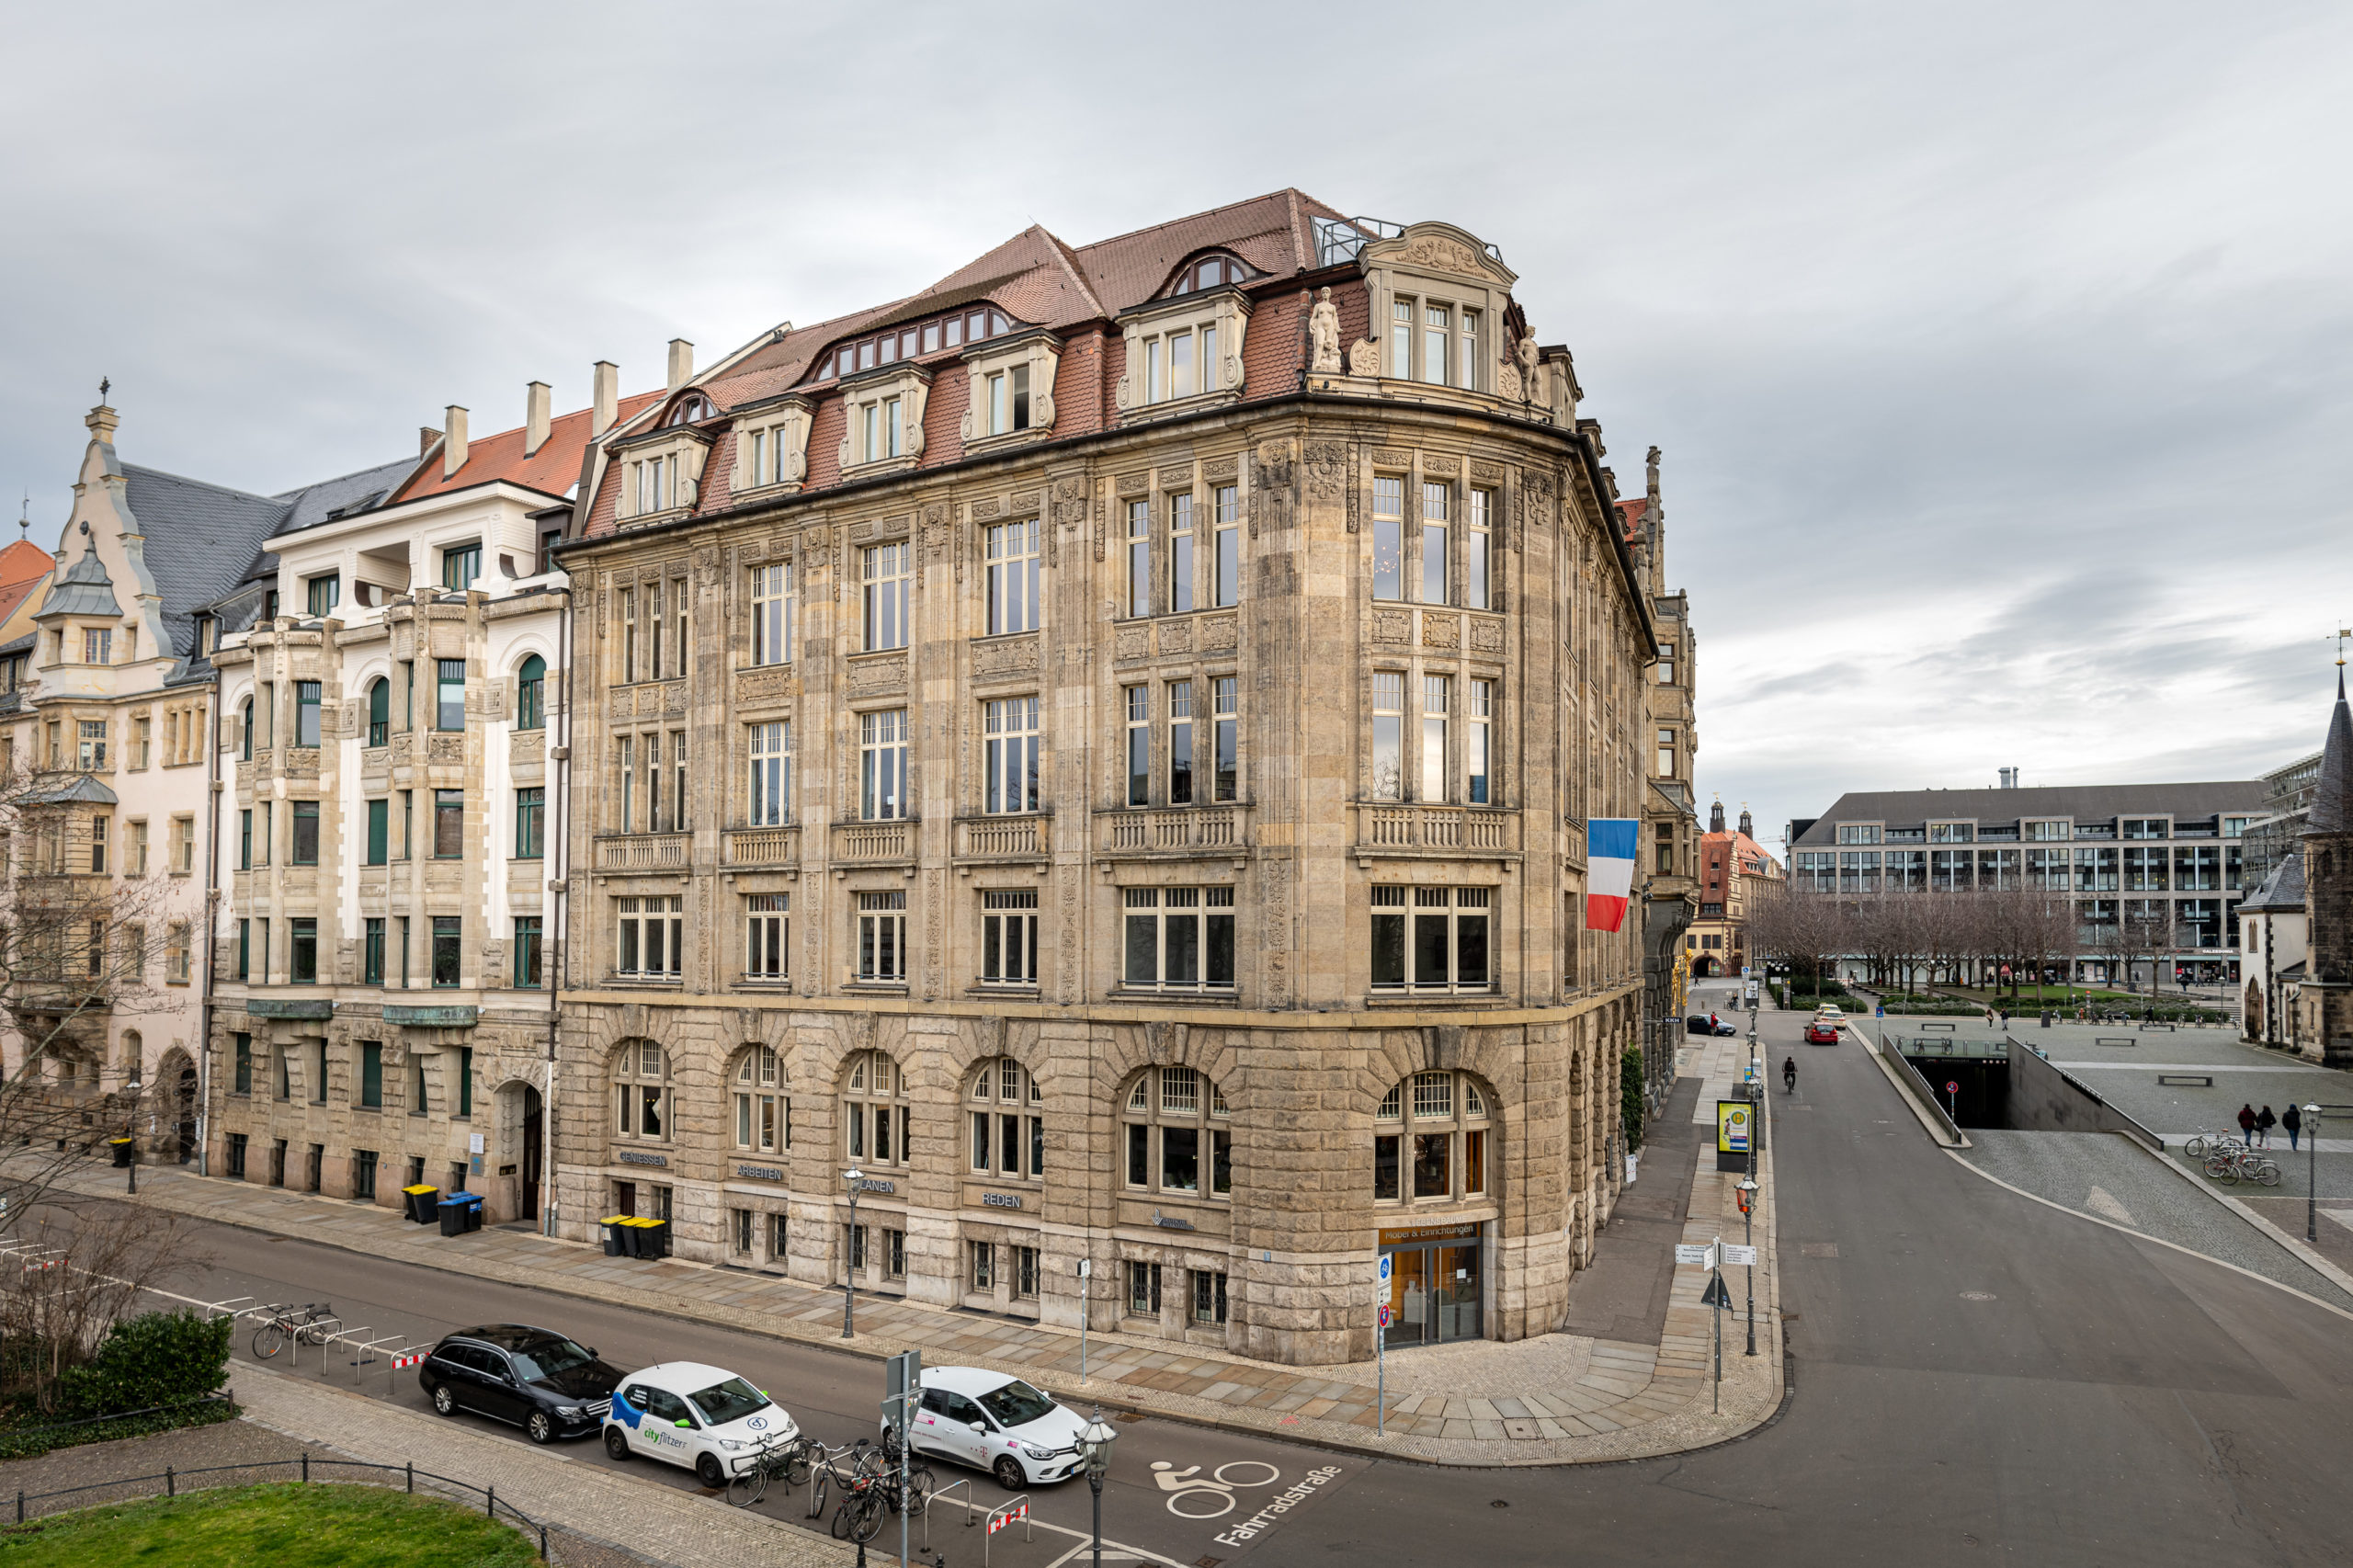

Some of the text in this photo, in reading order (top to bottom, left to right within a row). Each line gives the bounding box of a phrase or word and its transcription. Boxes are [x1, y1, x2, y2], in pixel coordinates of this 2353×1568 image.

[620, 1152, 666, 1166] GENIESSEN
[736, 1165, 782, 1180] ARBEITEN
[982, 1192, 1020, 1209] REDEN
[1411, 1229, 1418, 1237] &
[1420, 1224, 1473, 1236] Einrichtungen
[1213, 1465, 1343, 1547] Fahrradstraße
